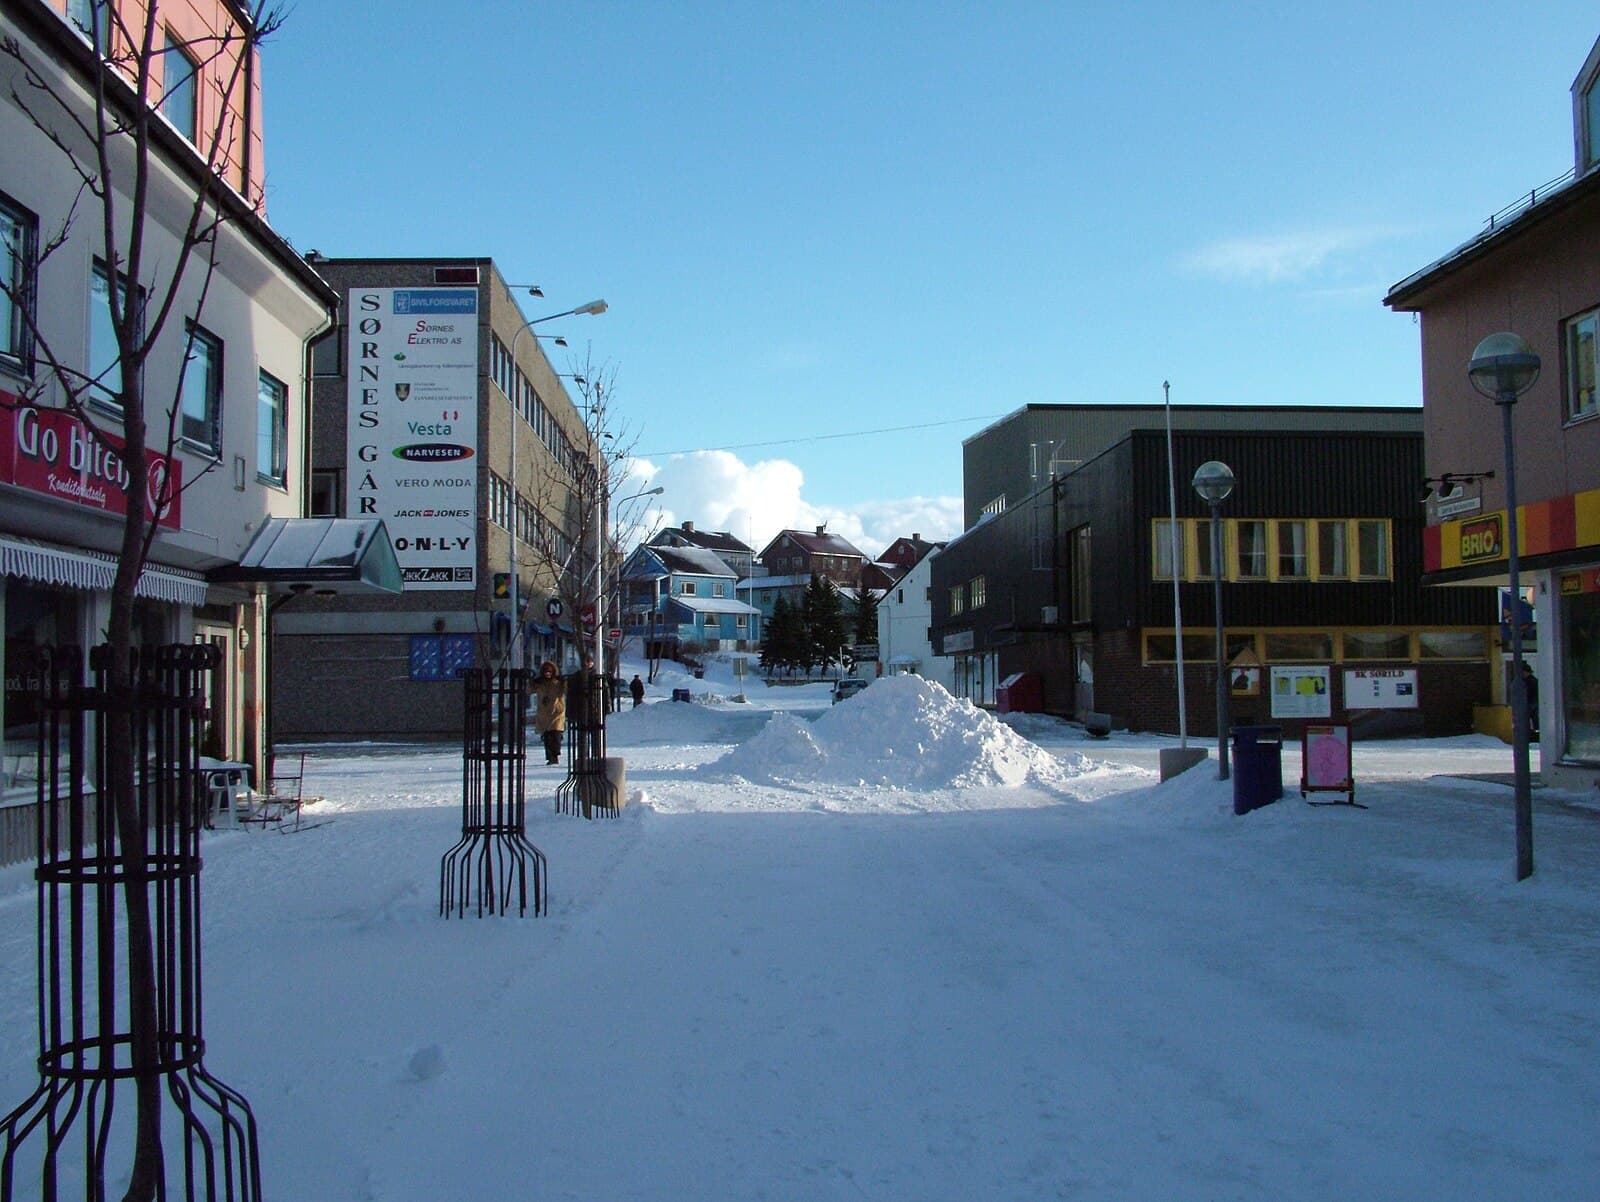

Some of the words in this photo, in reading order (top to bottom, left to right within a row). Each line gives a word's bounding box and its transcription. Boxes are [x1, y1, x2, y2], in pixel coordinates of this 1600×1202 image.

[450, 337, 462, 345] AS
[359, 294, 381, 428] SØRNES
[18, 407, 58, 462] Go
[408, 421, 452, 436] Vesta
[406, 449, 461, 457] NARVESEN
[395, 479, 429, 488] VERO
[433, 479, 472, 488] MODA
[394, 509, 422, 518] JACK
[434, 509, 470, 518] JONES
[395, 537, 470, 551] O-N-L-Y
[1462, 530, 1494, 557] BRIO
[548, 603, 561, 615] N
